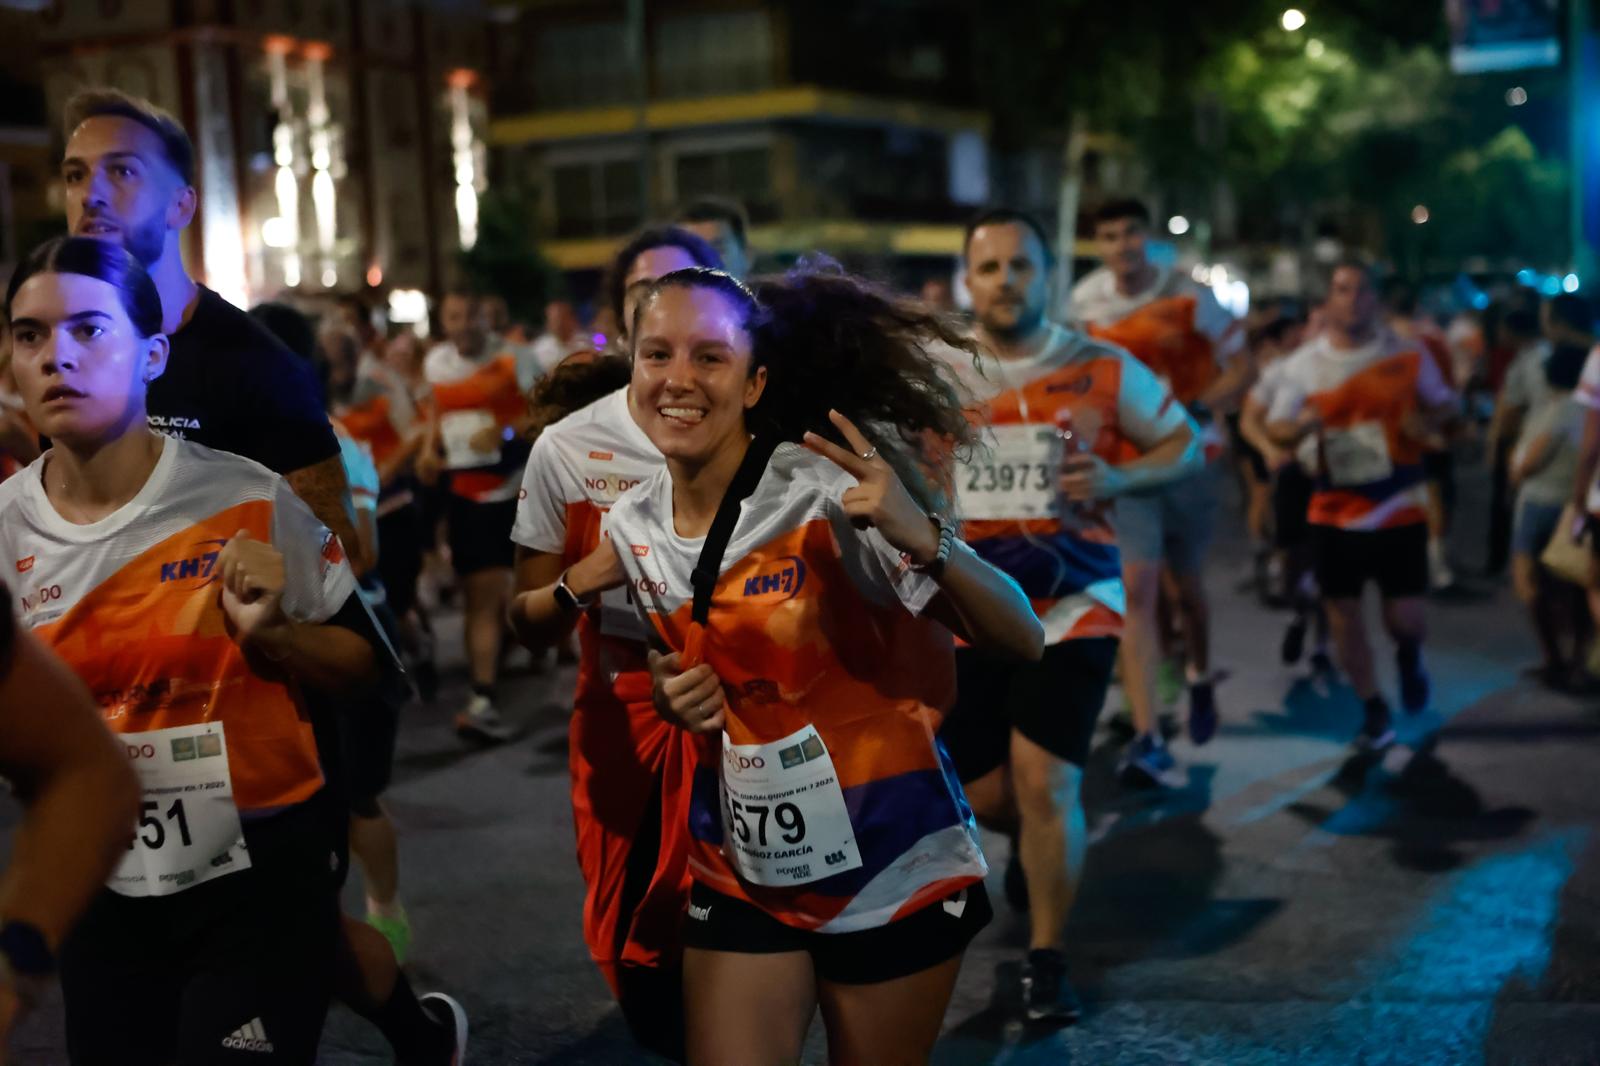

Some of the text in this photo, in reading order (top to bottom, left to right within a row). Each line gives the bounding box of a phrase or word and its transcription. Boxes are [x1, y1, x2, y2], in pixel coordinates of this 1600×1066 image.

[966, 463, 1050, 492] 23973
[129, 799, 192, 849] 51
[774, 845, 813, 859] GARCÍA
[222, 1037, 274, 1053] adidas
